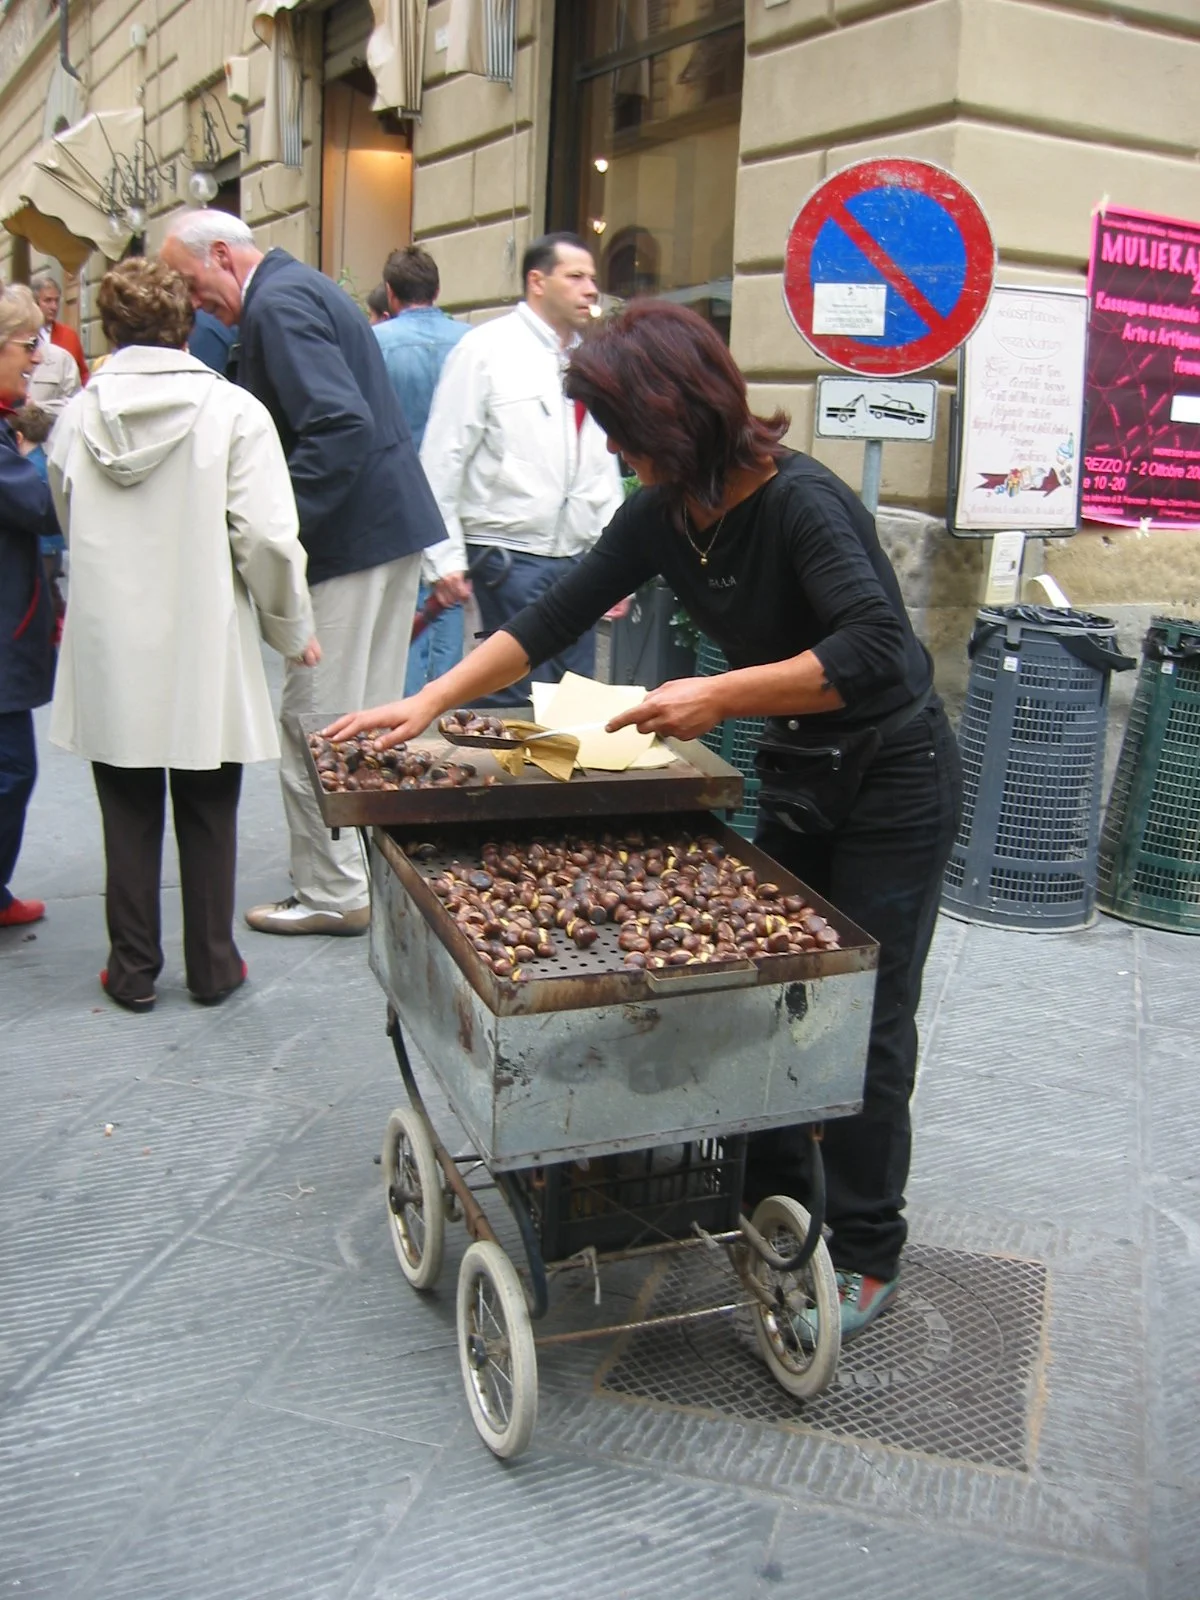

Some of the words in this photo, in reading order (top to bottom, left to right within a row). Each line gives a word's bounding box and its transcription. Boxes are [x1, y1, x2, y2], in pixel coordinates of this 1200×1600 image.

[1102, 232, 1200, 275] MULIERA
[1121, 322, 1148, 342] Arte
[1084, 456, 1123, 473] REZZO
[1139, 461, 1147, 476] 2
